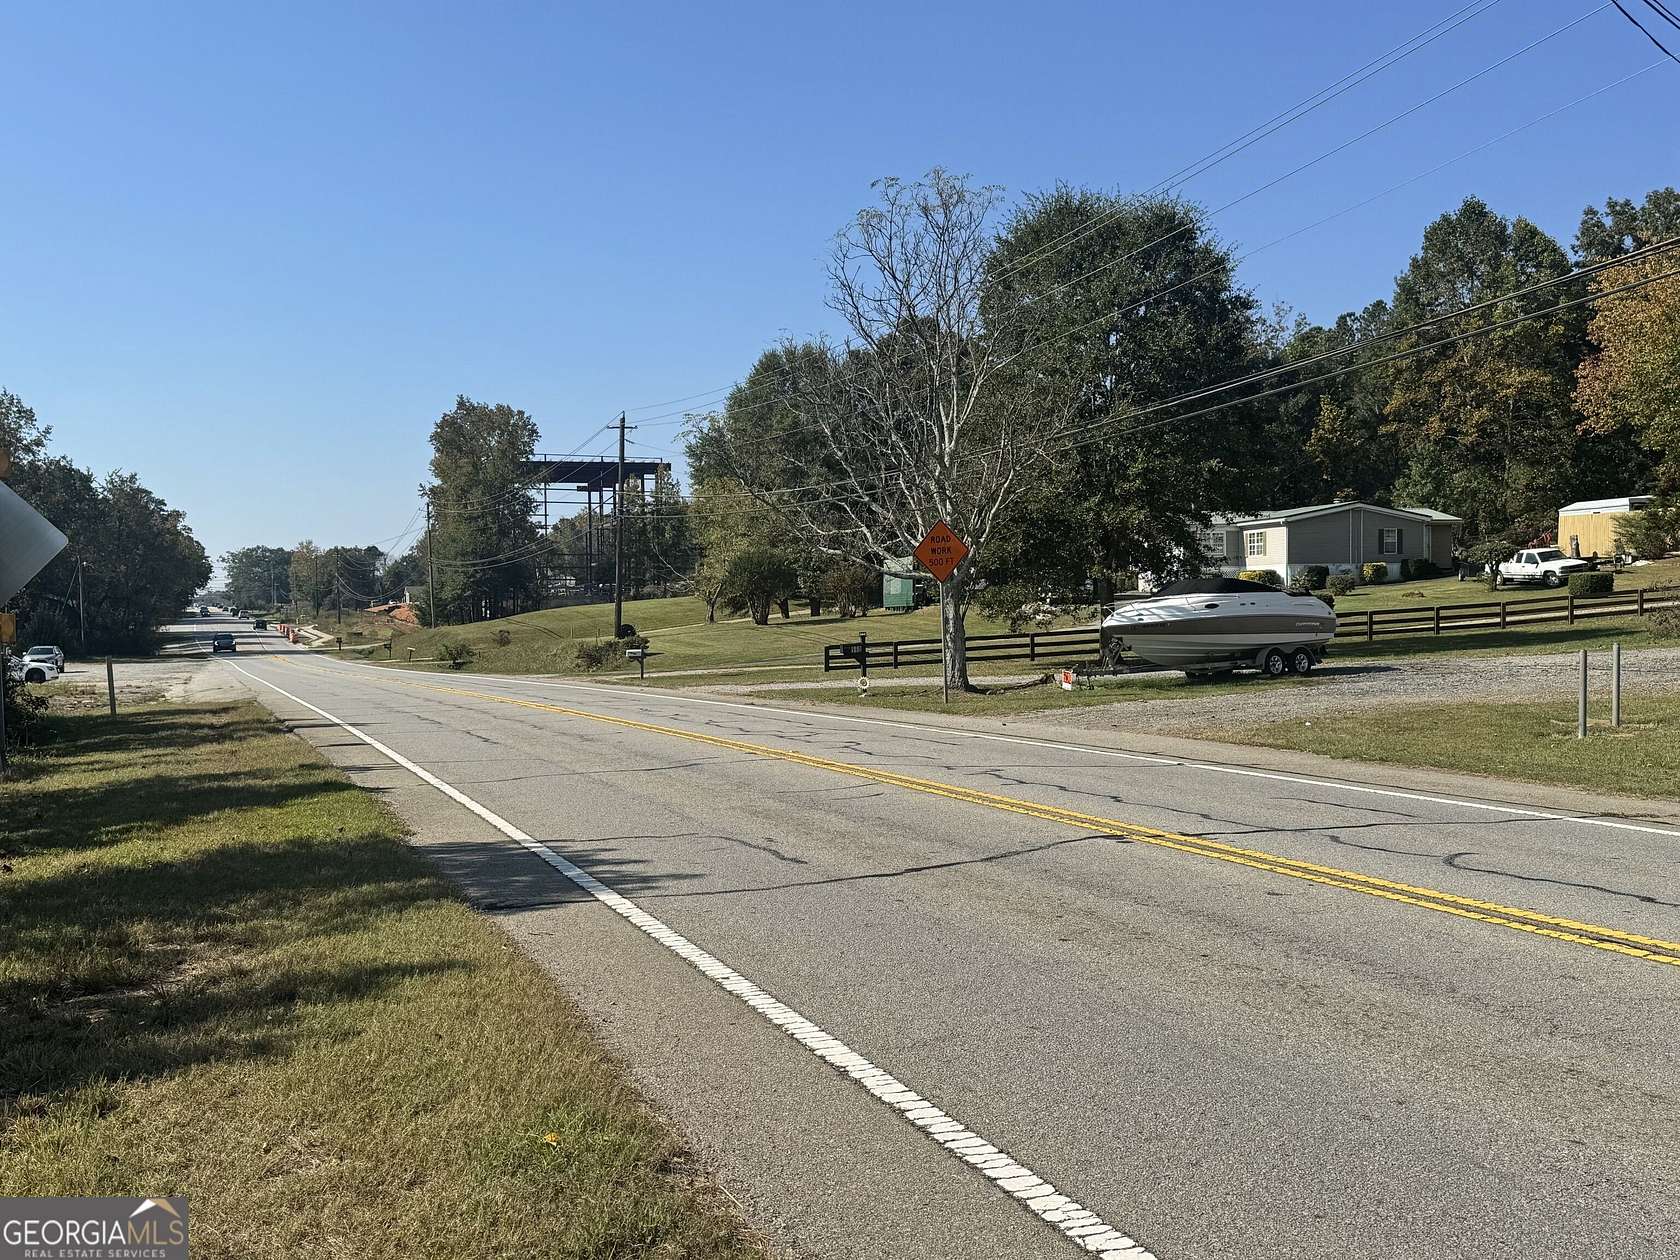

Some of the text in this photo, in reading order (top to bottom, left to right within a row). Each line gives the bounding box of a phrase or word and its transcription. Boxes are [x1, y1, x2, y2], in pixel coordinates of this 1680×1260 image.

[930, 535, 952, 544] ROAD
[930, 546, 952, 555] WORK
[929, 557, 954, 567] 500 FT
